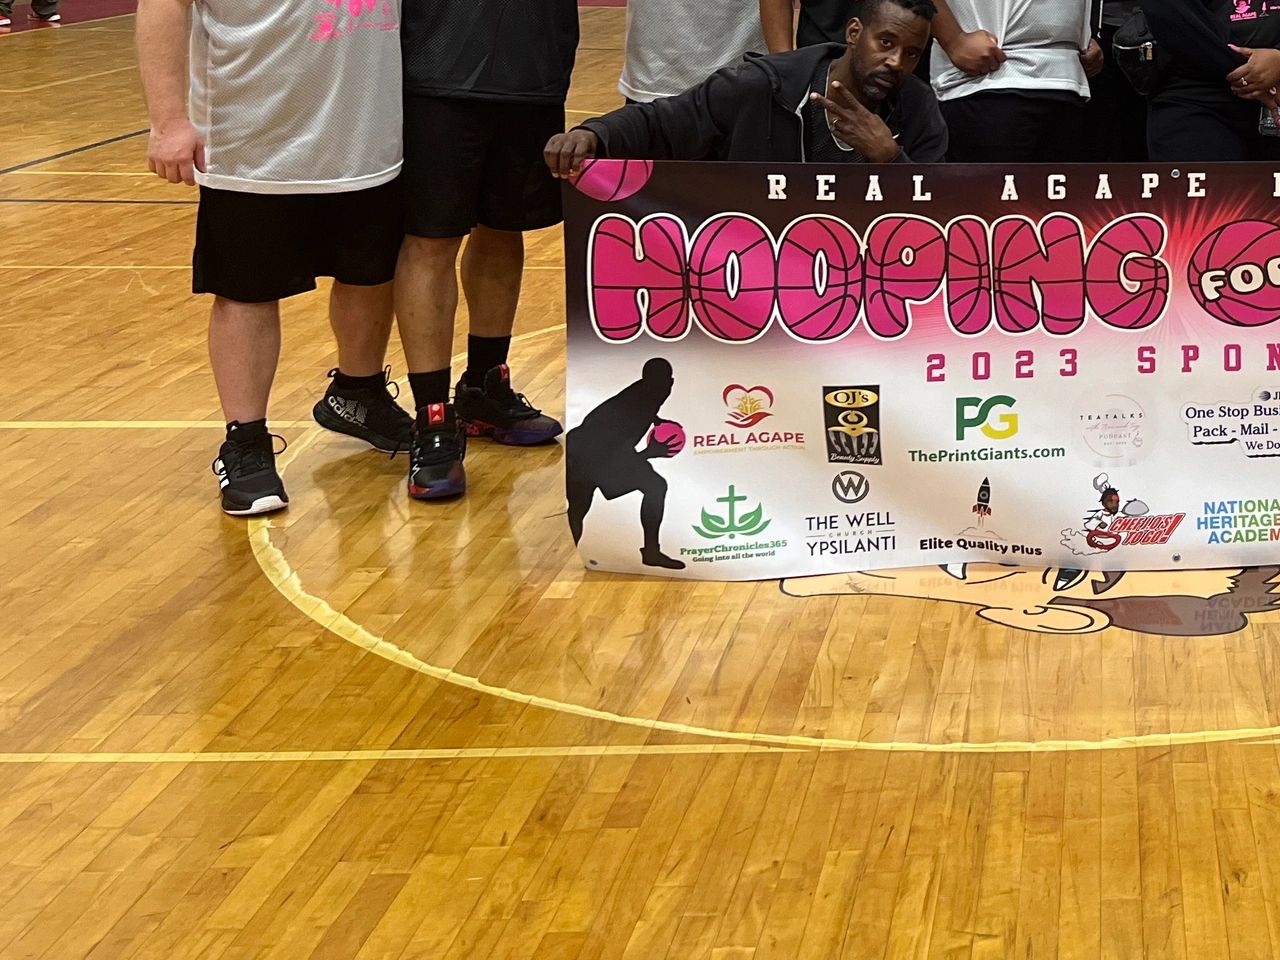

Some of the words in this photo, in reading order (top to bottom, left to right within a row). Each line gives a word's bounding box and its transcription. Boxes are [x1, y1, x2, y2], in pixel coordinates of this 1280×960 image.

[767, 174, 933, 202] REAL
[1000, 171, 1207, 201] AGAPE
[589, 211, 1170, 344] HOOPING
[925, 348, 1078, 382] 2023
[833, 391, 869, 406] OJ's
[955, 394, 1018, 441] PG
[1185, 406, 1215, 419] One
[1218, 405, 1250, 419] Stop
[1192, 424, 1228, 437] Pack
[1240, 422, 1269, 435] Mail
[693, 433, 741, 448] REAL
[744, 431, 805, 445] AGAPE
[1245, 441, 1264, 450] We
[1266, 440, 1280, 449] Do
[908, 446, 1066, 463] ThePrintGiants.com
[804, 514, 840, 531] THE
[845, 511, 896, 528] WELL
[828, 529, 873, 538] CHURCH
[679, 539, 788, 556] PrayerChronicles365
[806, 535, 896, 556] YPSILANTI
[919, 538, 954, 551] Elite
[956, 538, 1009, 555] Quality
[1011, 544, 1043, 556] Plus
